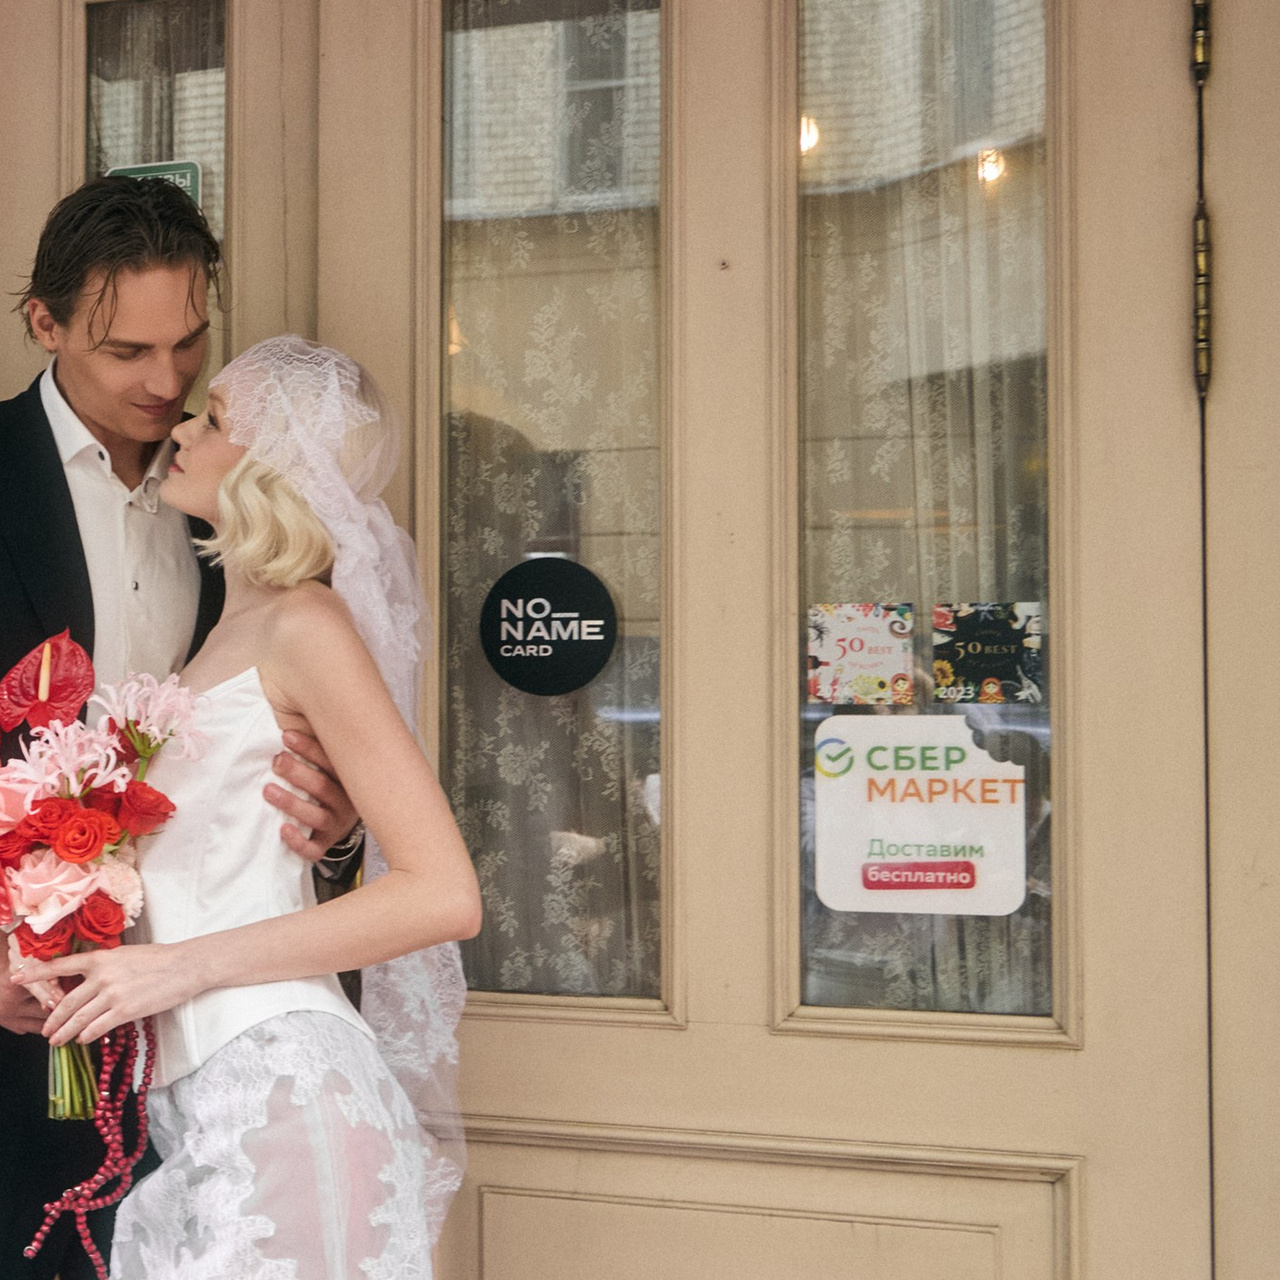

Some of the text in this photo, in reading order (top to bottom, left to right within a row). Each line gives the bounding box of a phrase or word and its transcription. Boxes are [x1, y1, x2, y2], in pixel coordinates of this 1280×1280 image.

[500, 620, 604, 640] NAME
[500, 645, 553, 657] CARD
[835, 637, 894, 660] 50 BEST
[955, 642, 1017, 661] 50 BEST
[938, 686, 975, 702] 2023
[866, 745, 967, 771] СБЕР
[867, 777, 1026, 804] МАРКЕТ
[867, 839, 985, 858] Доставим
[867, 866, 971, 884] бесплатно
